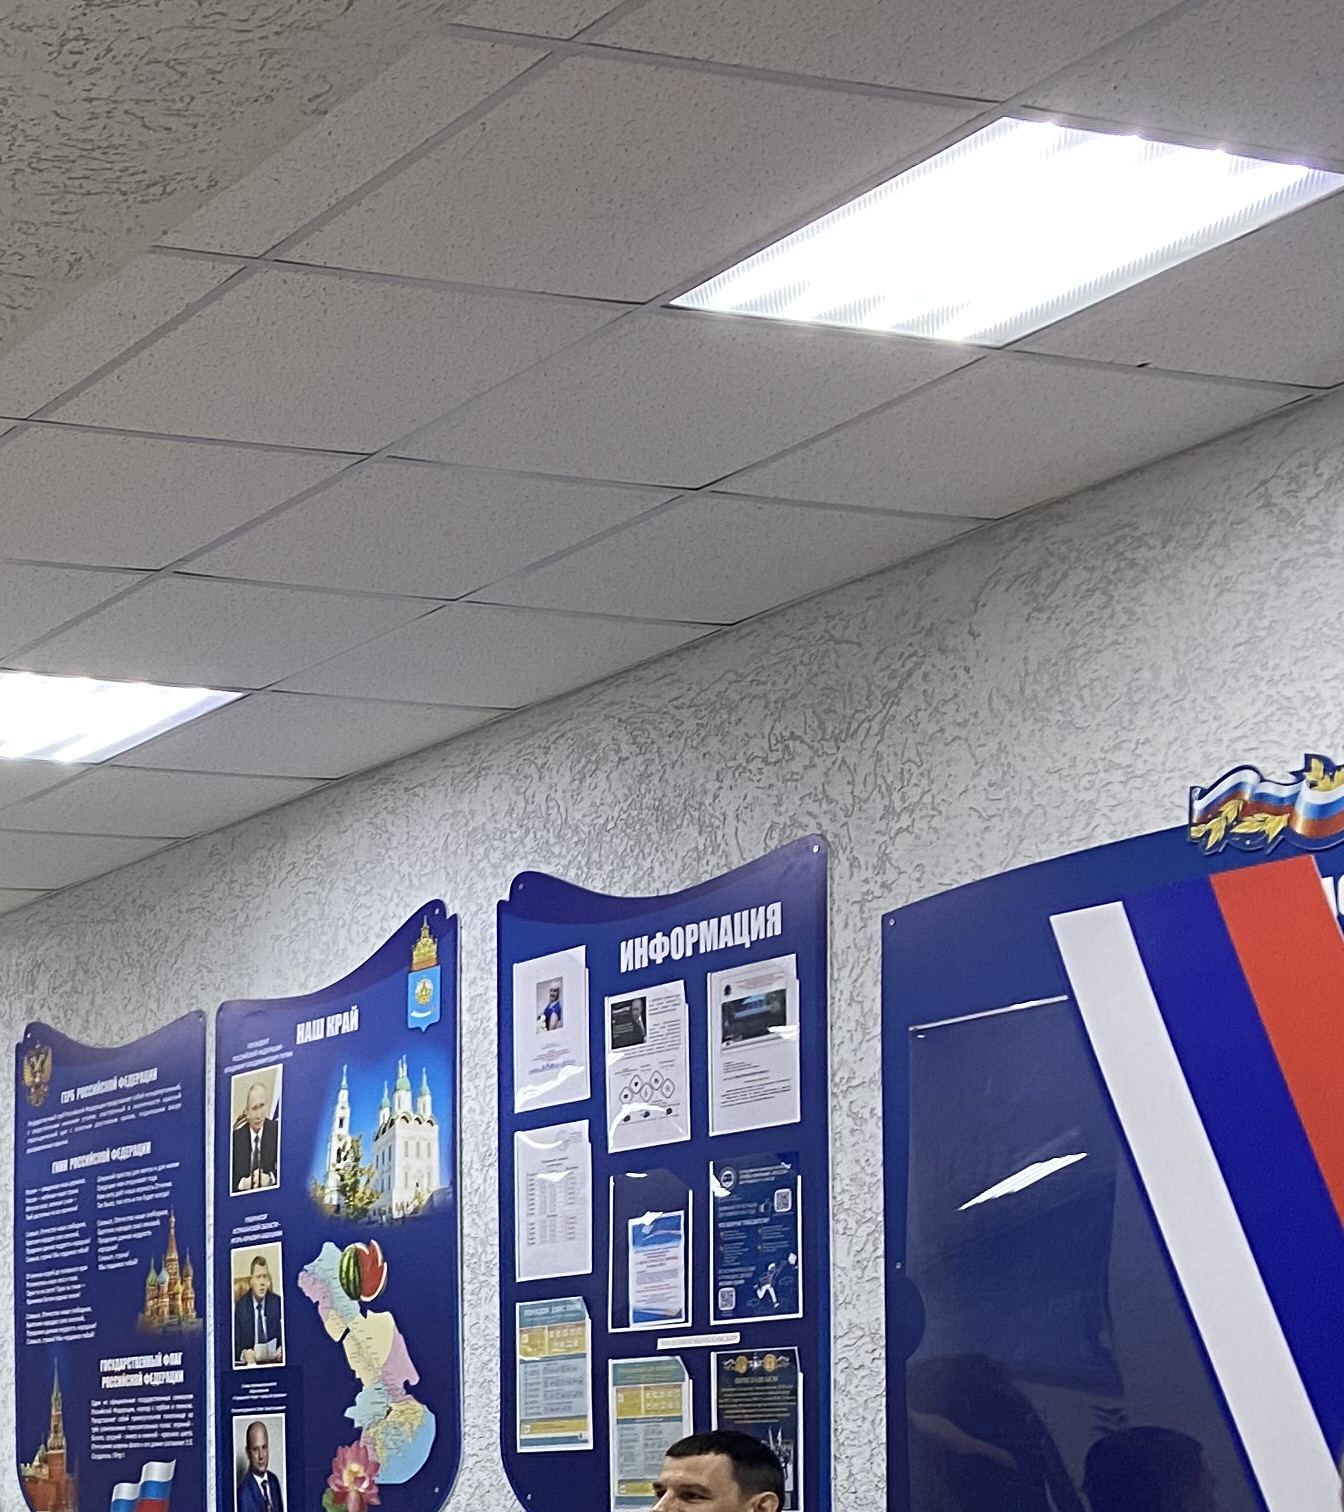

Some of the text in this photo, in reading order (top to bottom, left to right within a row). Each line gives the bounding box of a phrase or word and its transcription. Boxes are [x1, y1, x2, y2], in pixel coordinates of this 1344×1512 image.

[620, 901, 782, 973] ИНФОРМАЦИЯ
[296, 1004, 359, 1045] НАШ КРАЙ
